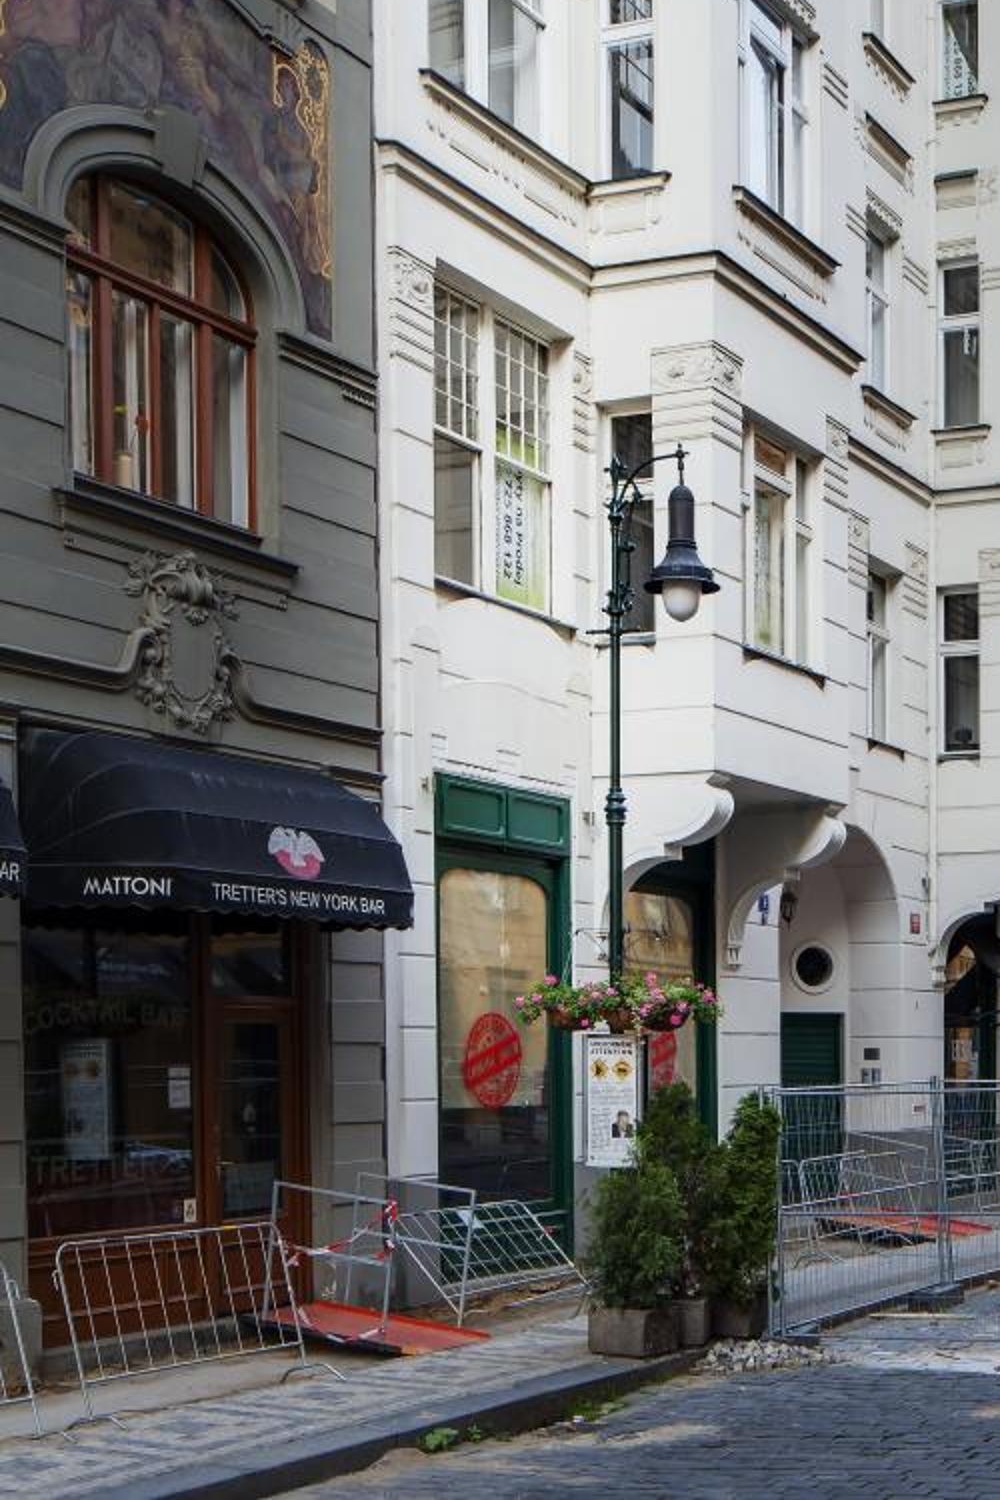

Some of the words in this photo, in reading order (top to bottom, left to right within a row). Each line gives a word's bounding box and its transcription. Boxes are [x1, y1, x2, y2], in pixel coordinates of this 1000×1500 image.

[83, 876, 172, 896] MATTONI
[212, 882, 287, 905] TRETTER'S
[290, 889, 320, 908] NEW
[322, 893, 359, 912] YORK
[361, 897, 385, 915] BAR
